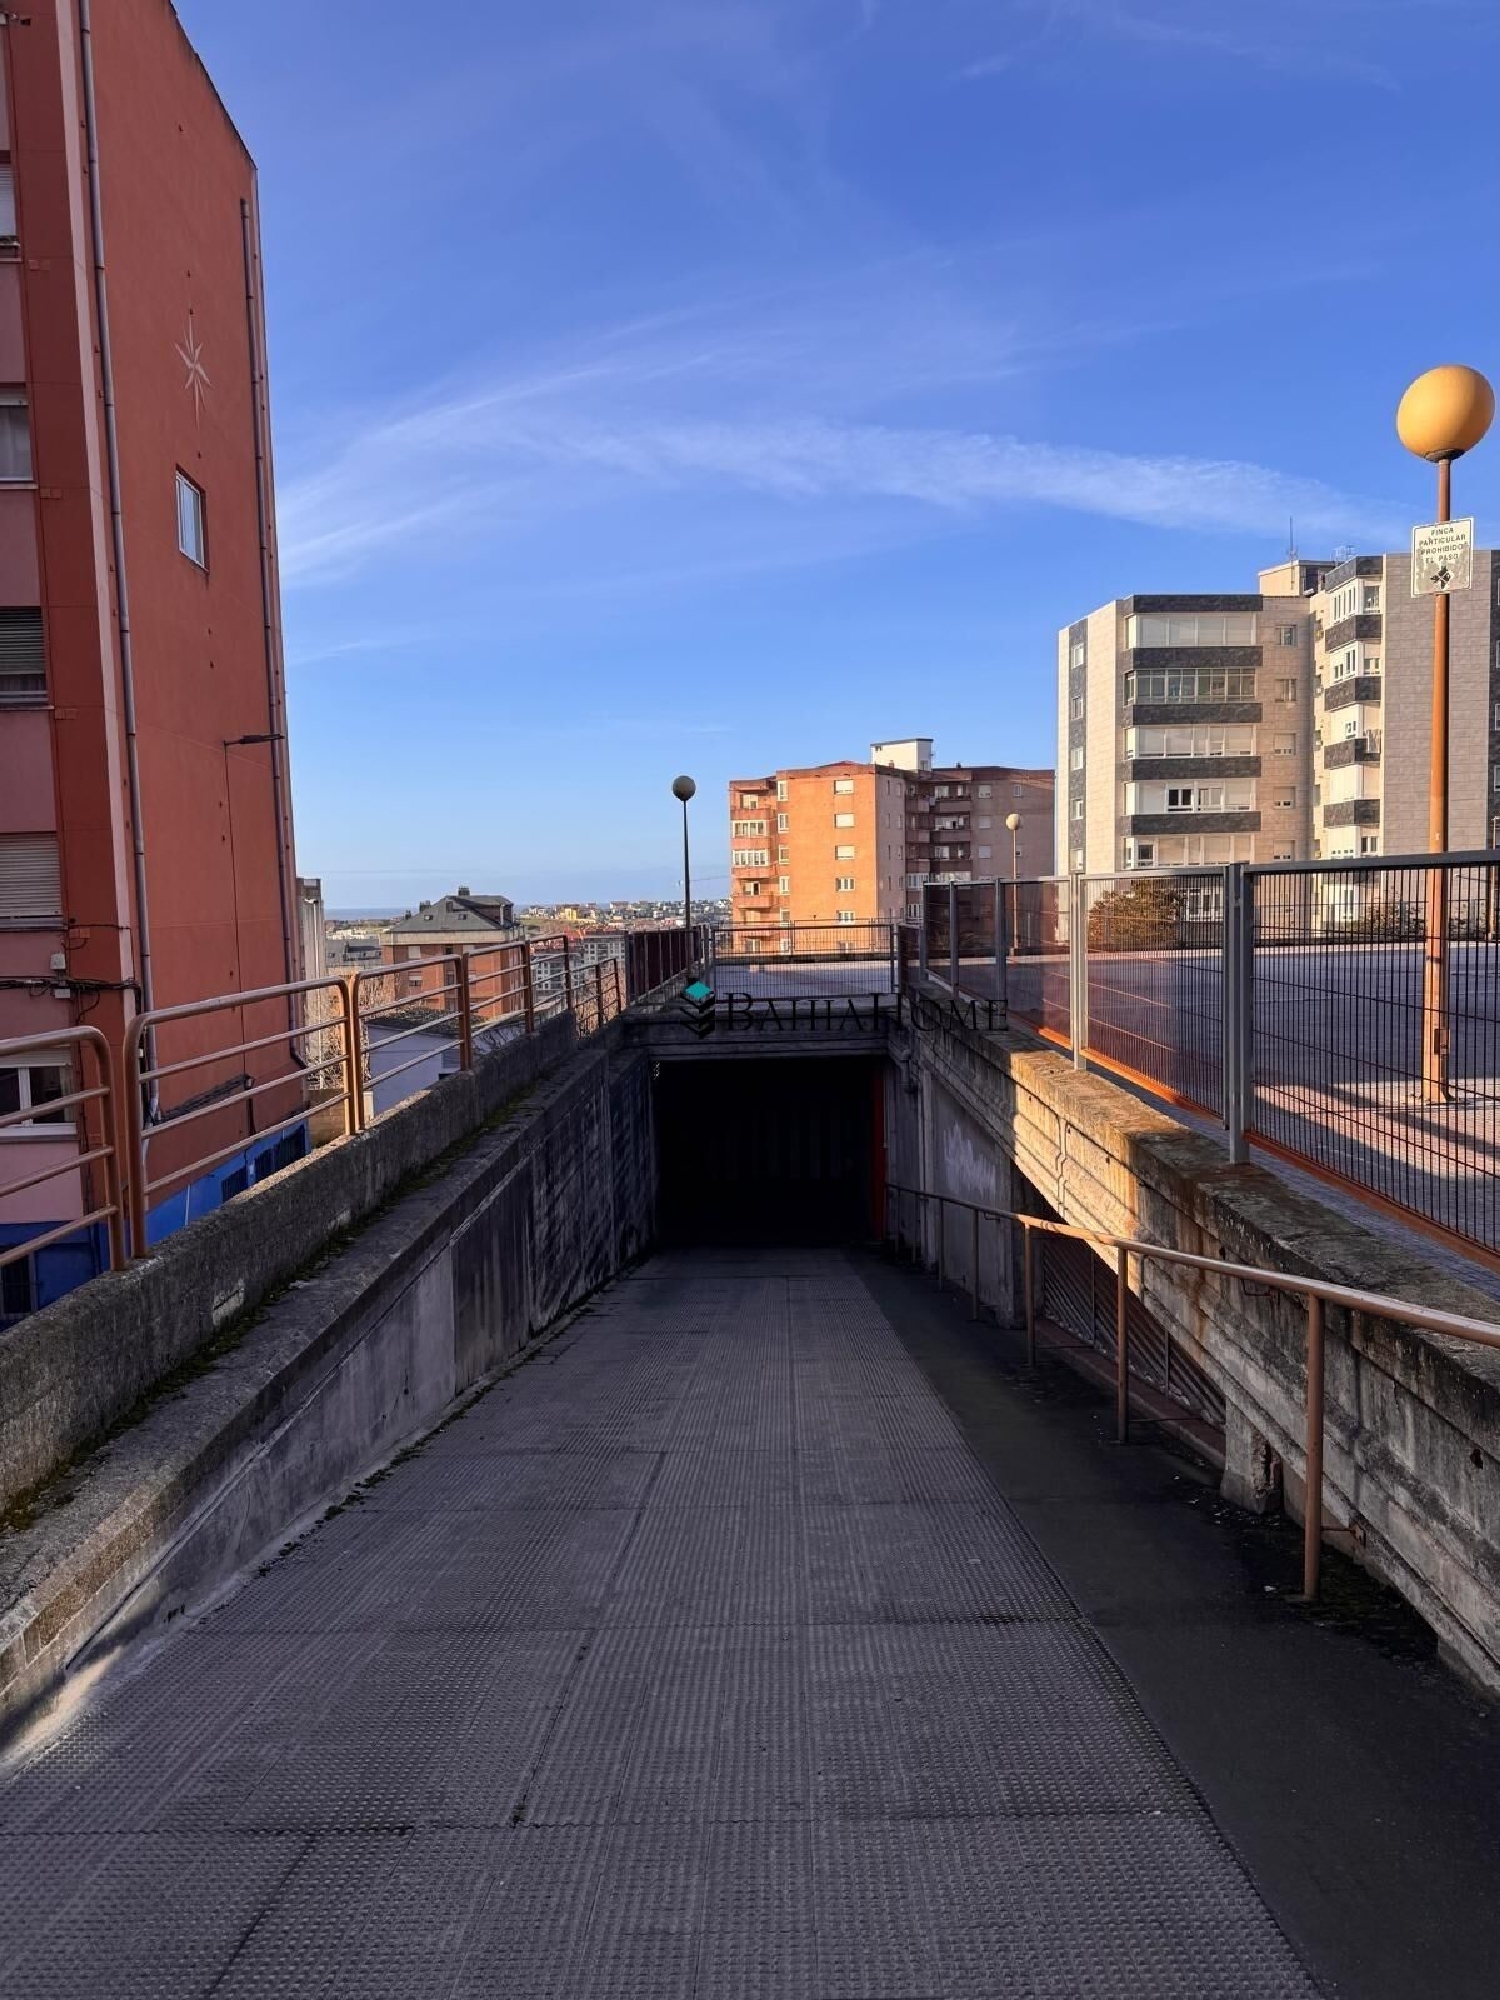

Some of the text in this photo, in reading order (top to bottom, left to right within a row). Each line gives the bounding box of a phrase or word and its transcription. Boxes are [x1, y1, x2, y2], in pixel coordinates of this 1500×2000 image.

[1430, 527, 1454, 536] FINCA
[1419, 534, 1466, 546] PARTICULAR
[1420, 543, 1464, 555] PROHIBIDO
[1438, 553, 1459, 561] PASO
